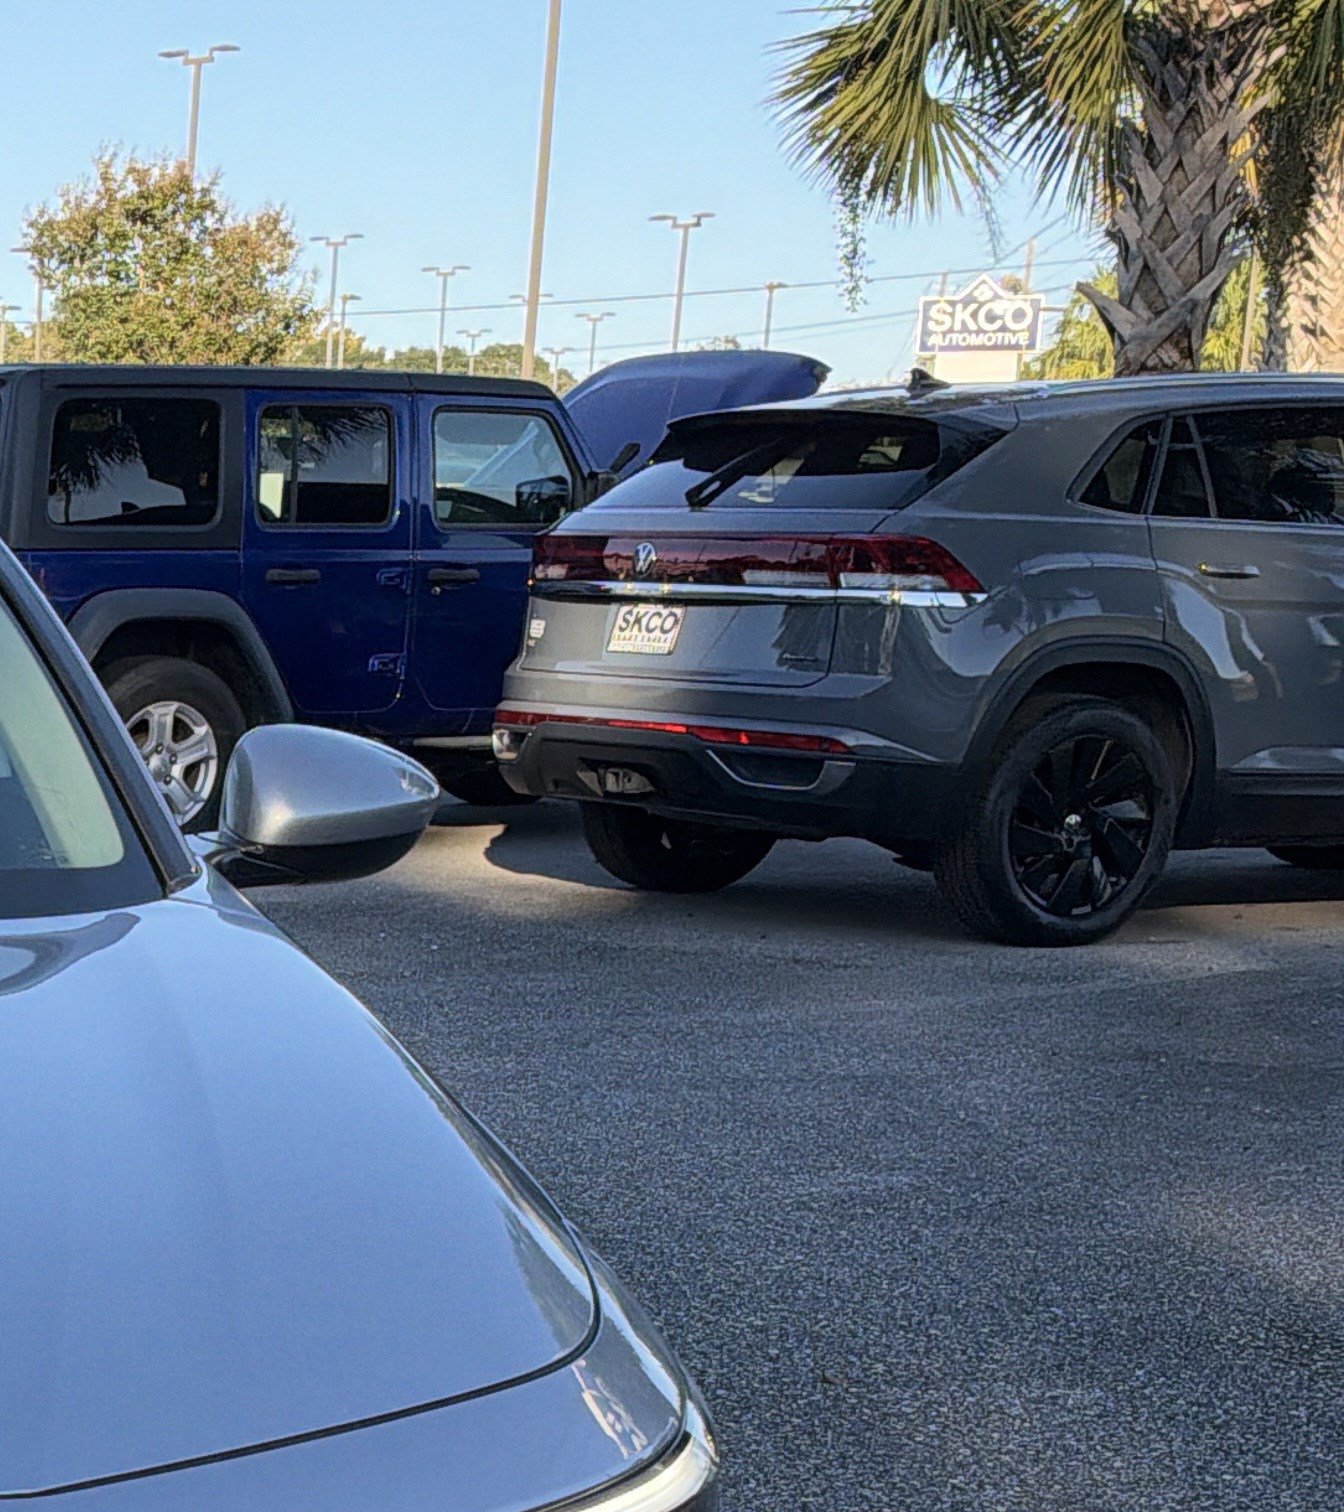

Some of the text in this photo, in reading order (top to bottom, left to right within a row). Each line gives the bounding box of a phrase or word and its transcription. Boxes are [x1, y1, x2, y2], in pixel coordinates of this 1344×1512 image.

[927, 302, 1033, 331] SKCO
[927, 331, 1030, 346] AUTOMOTIVE
[619, 609, 680, 634] SKCO
